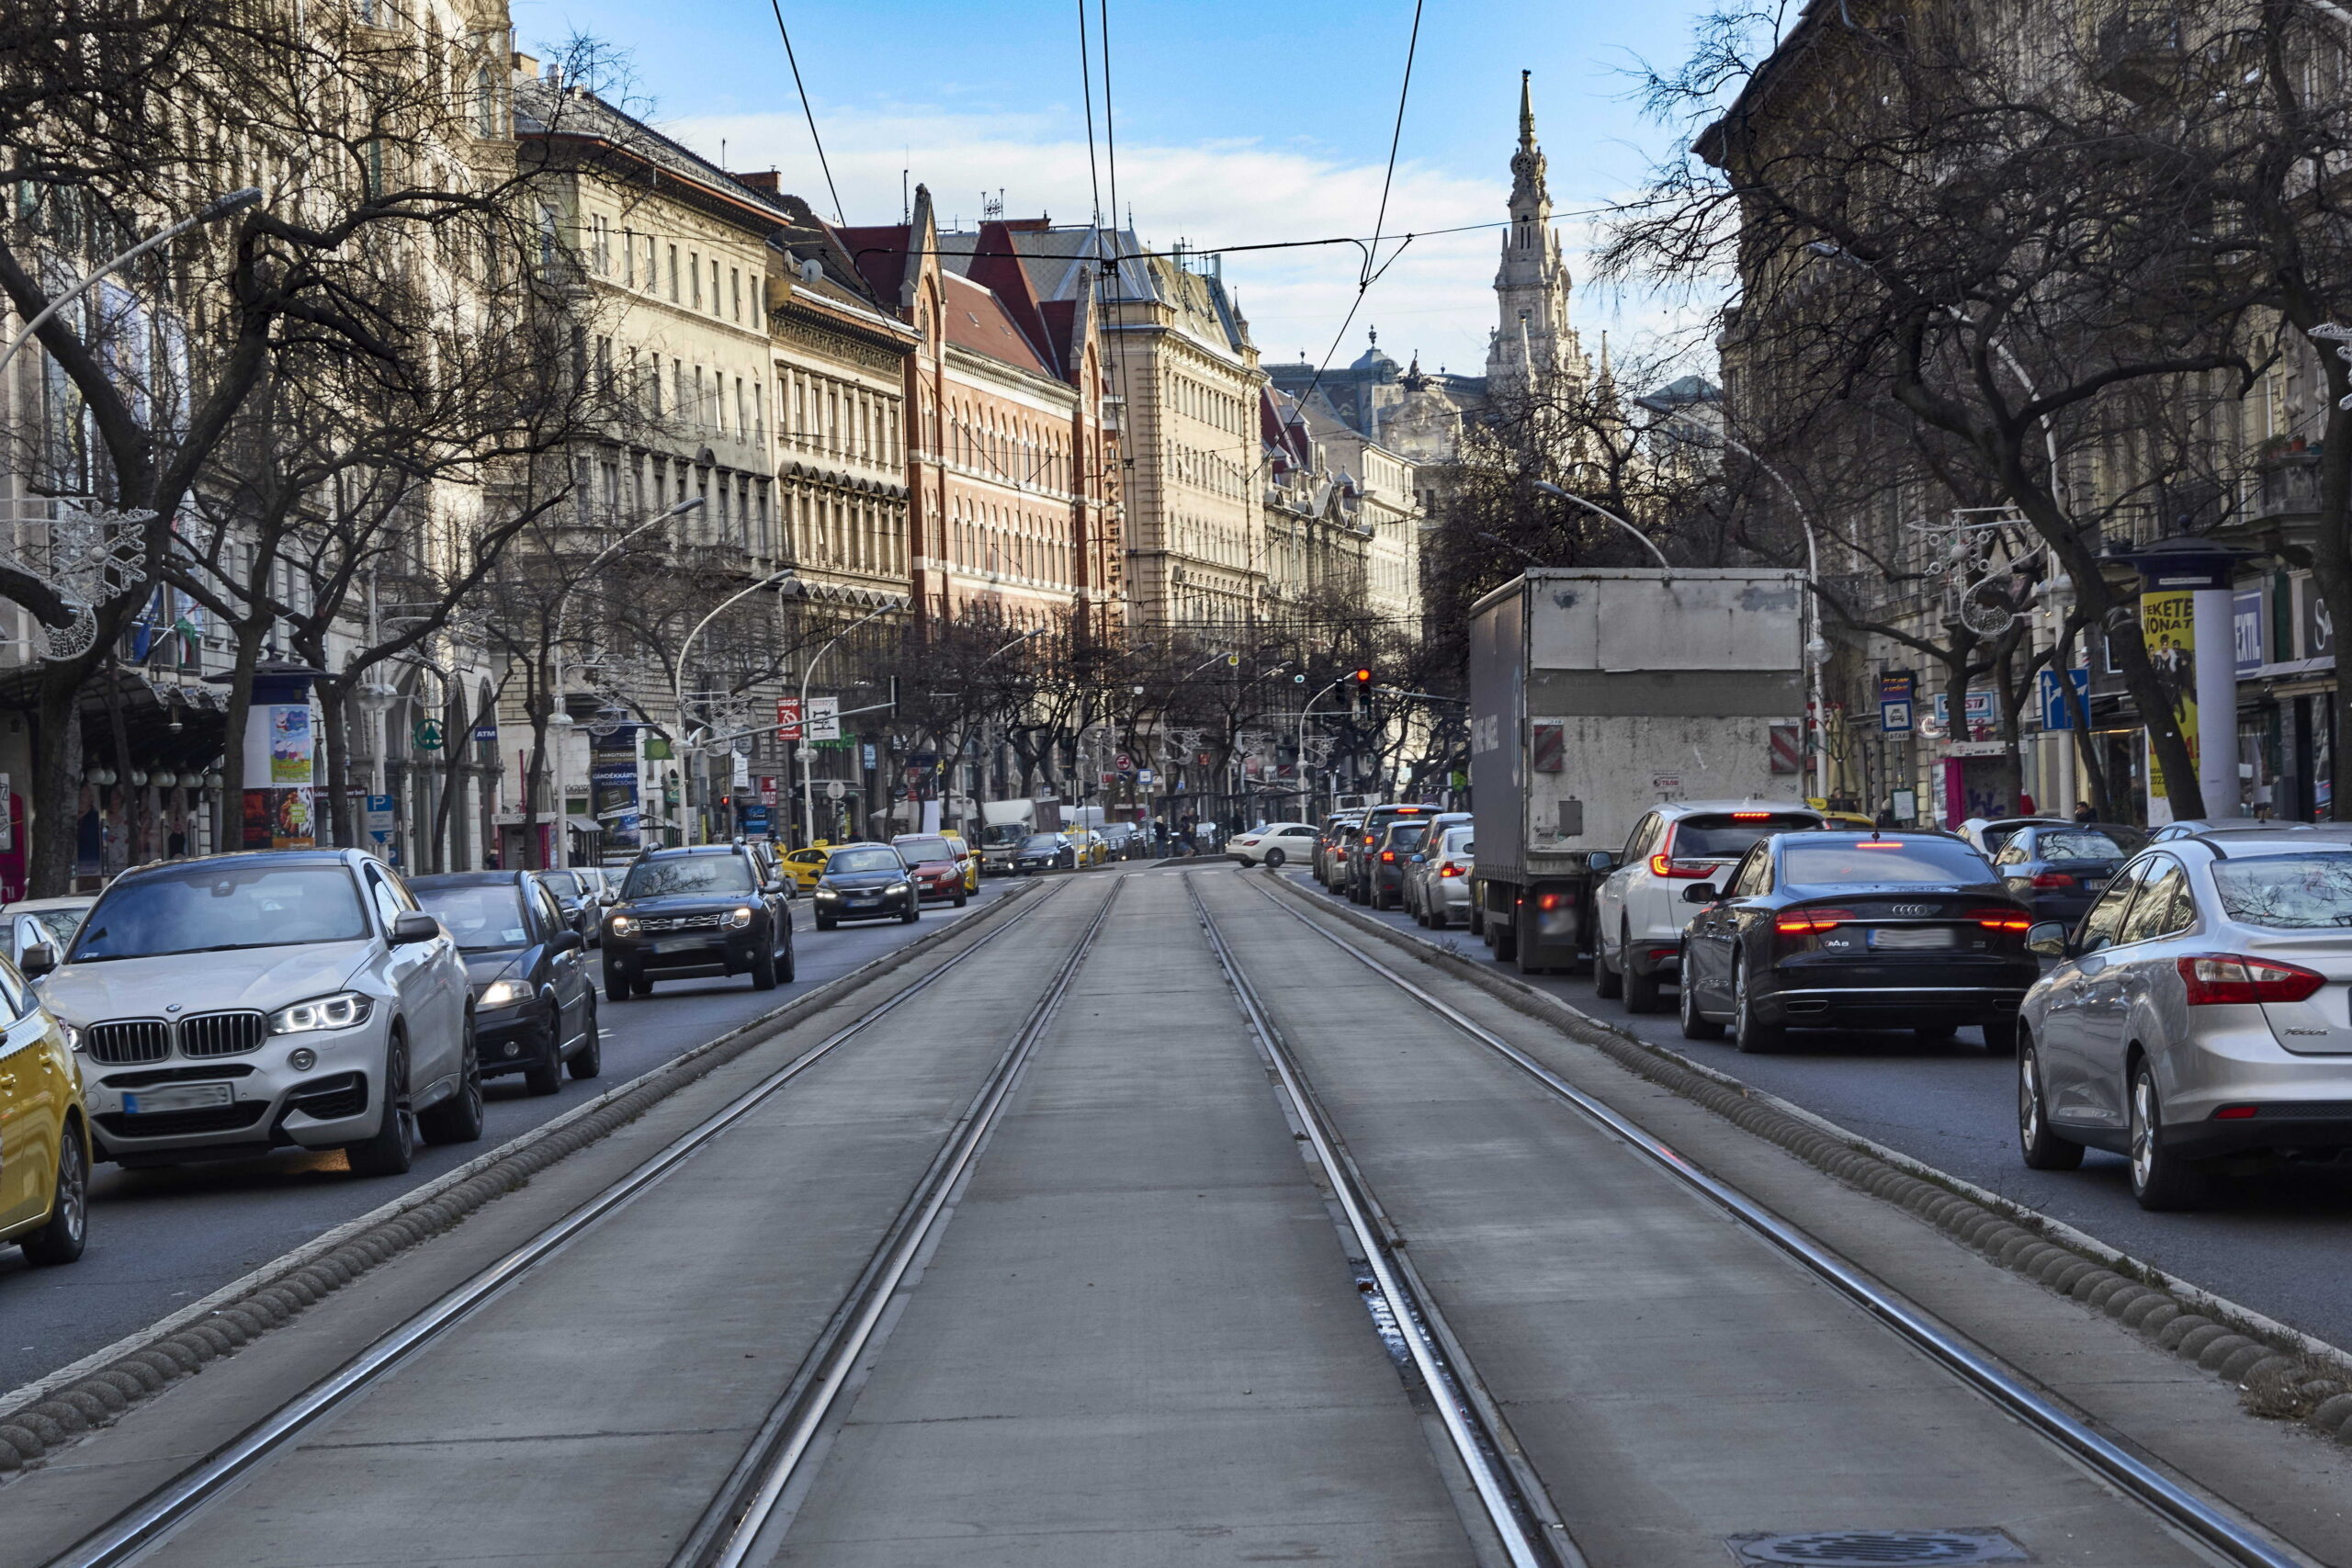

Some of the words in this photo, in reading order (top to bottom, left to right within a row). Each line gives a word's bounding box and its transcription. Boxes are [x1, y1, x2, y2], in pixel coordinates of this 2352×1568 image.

[2143, 597, 2194, 617] FEKETE
[2143, 617, 2194, 635] VONAT
[2233, 611, 2260, 662] EXTIL
[373, 795, 386, 810] P
